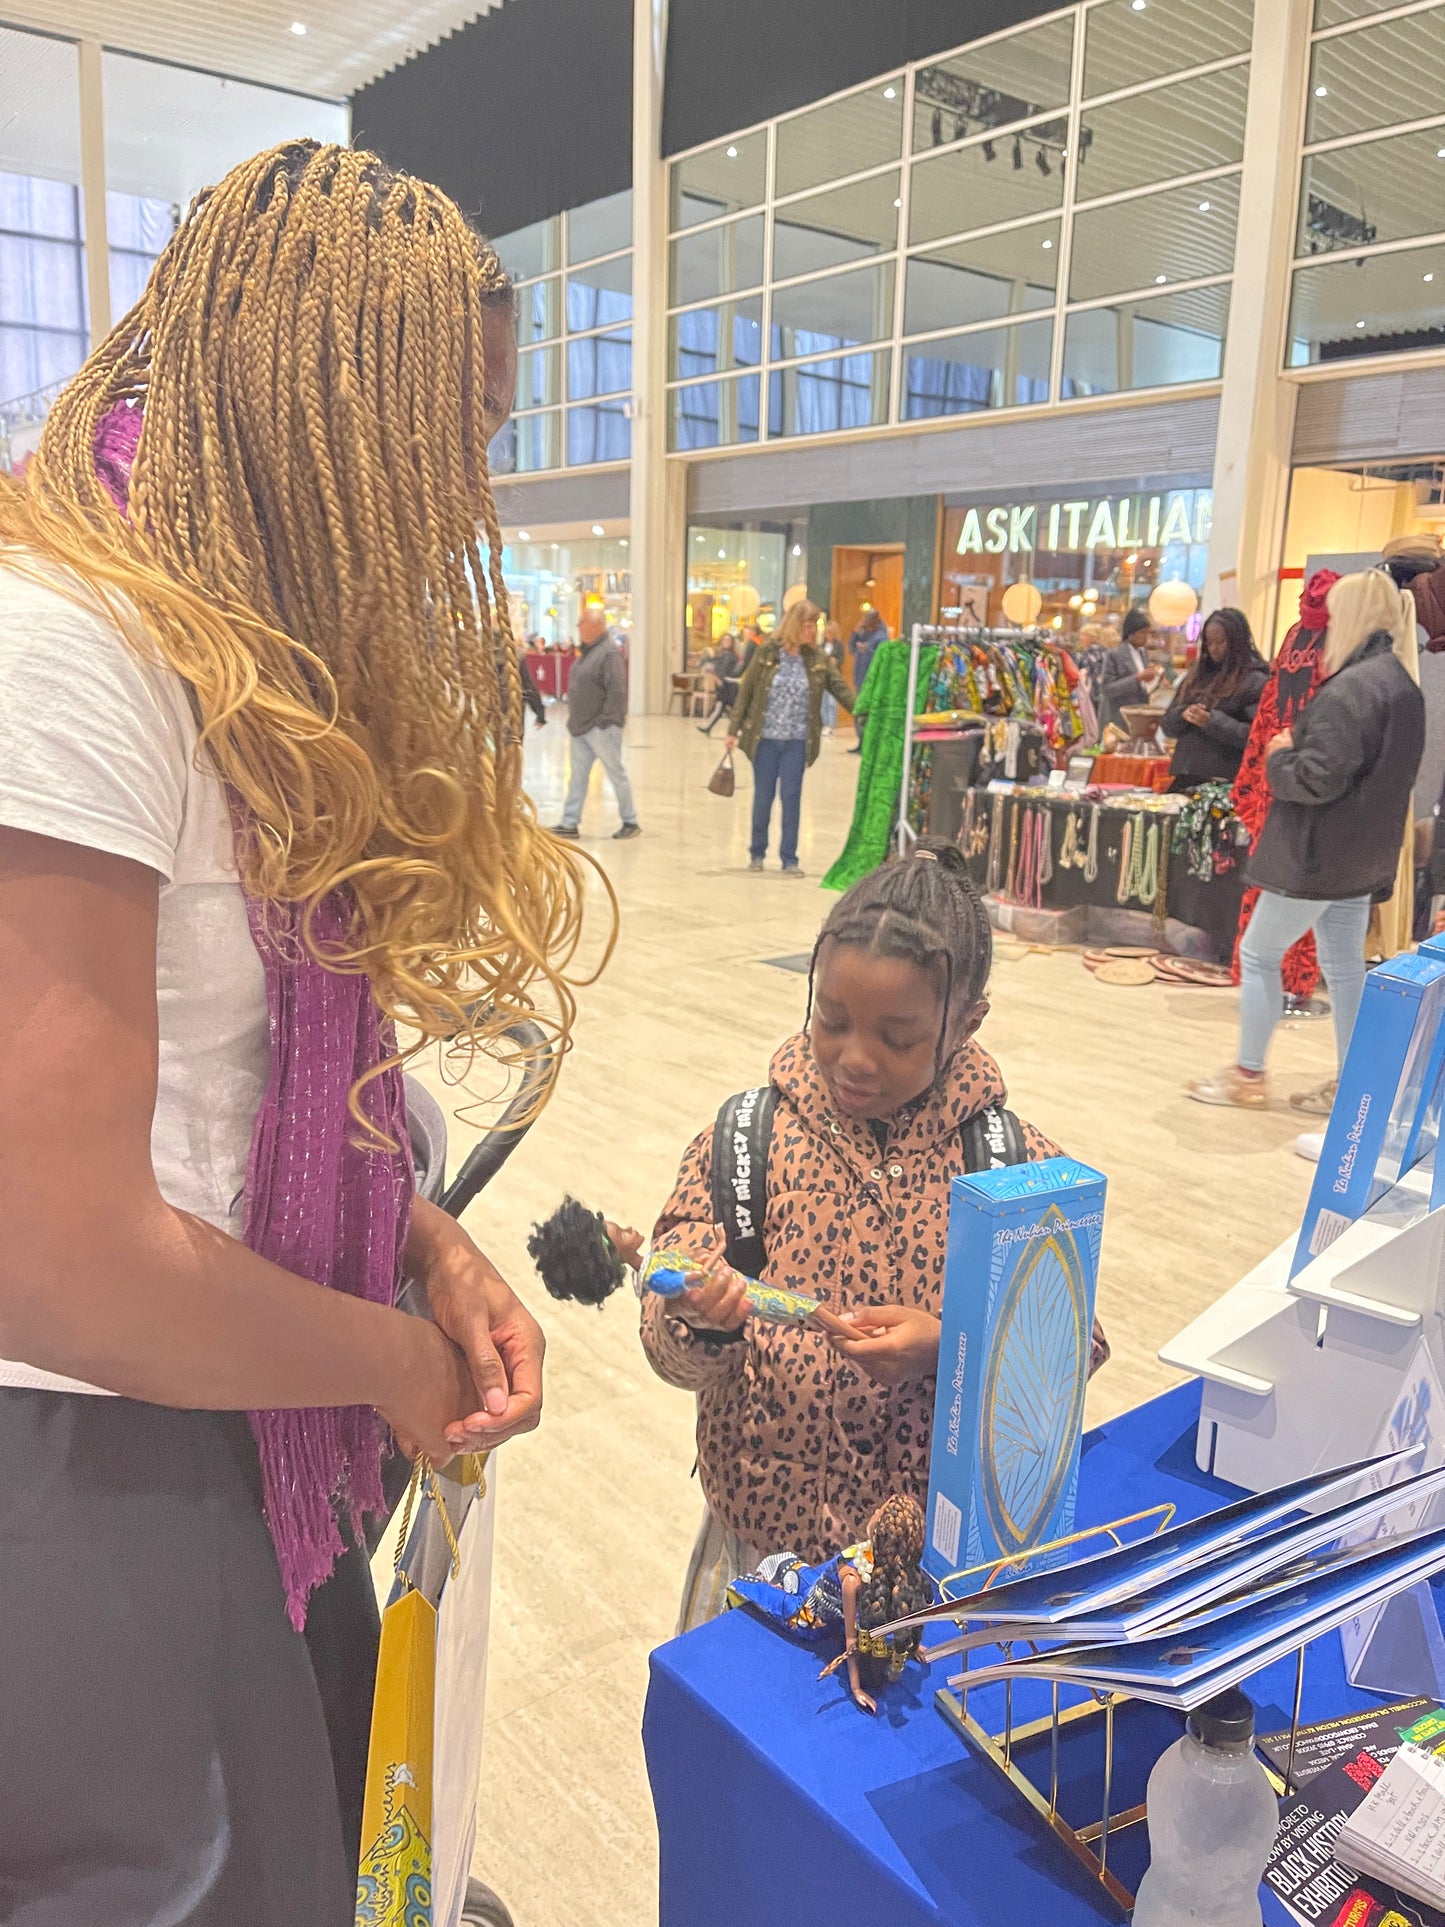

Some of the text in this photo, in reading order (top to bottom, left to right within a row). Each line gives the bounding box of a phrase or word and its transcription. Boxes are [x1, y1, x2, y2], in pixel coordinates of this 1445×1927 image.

[956, 504, 1035, 556] ASK
[1333, 1093, 1372, 1194] The Nubian Princesses
[997, 1213, 1101, 1245] The Nubian Princesses
[947, 1331, 967, 1456] The Nubian Princesses
[370, 1762, 396, 1861] Princesses
[1280, 1834, 1294, 1849] BY
[1290, 1810, 1325, 1839] VISITING
[1267, 1847, 1320, 1895] BLACK
[1292, 1861, 1361, 1919] EXHIBITIO
